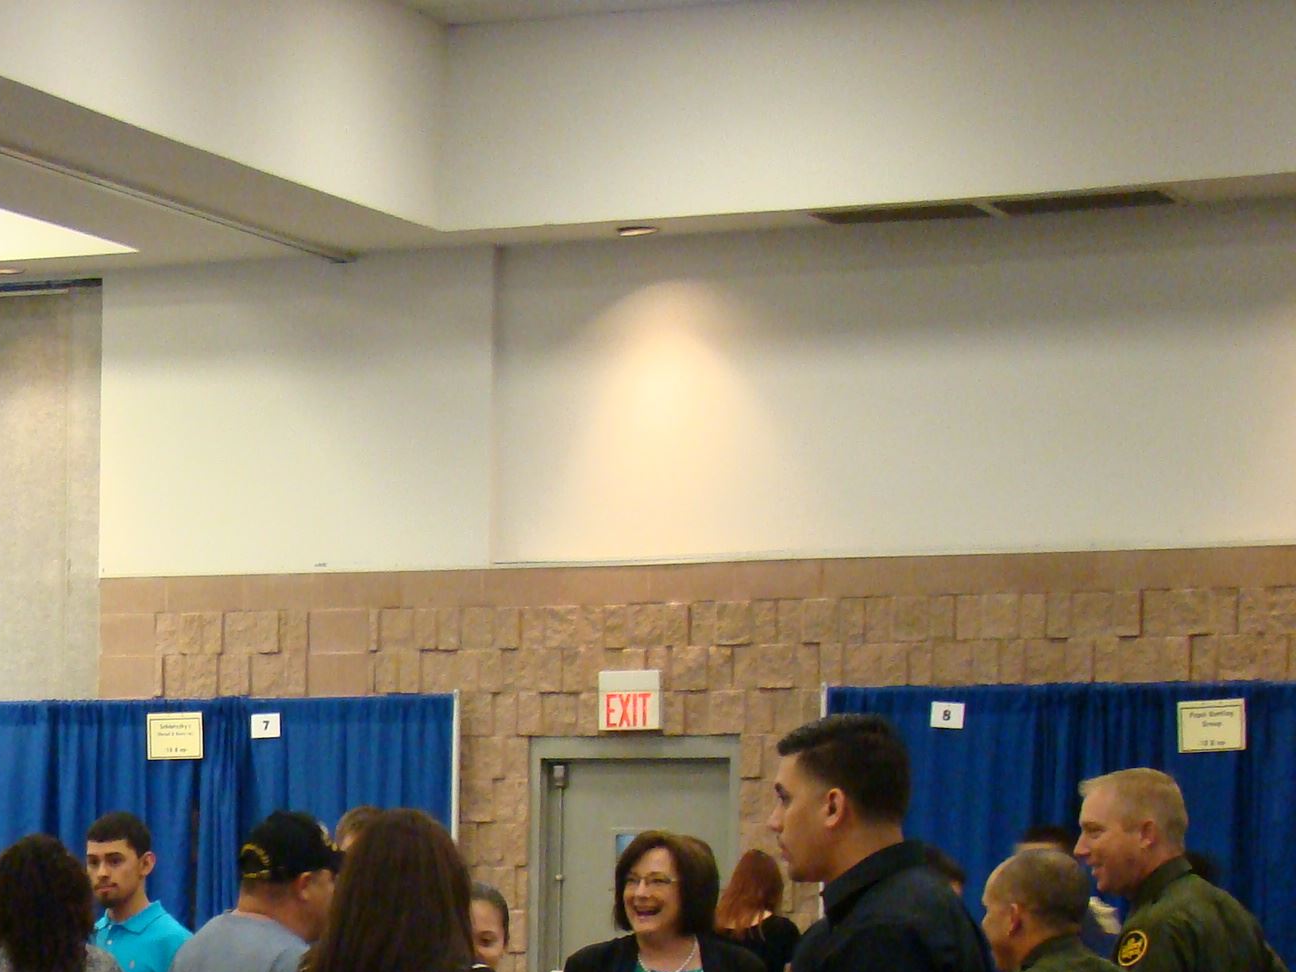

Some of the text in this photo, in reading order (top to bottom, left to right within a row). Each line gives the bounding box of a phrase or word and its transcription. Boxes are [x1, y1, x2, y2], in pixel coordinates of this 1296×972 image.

[606, 693, 652, 728] EXIT
[942, 709, 951, 721] 8
[262, 720, 270, 731] 7
